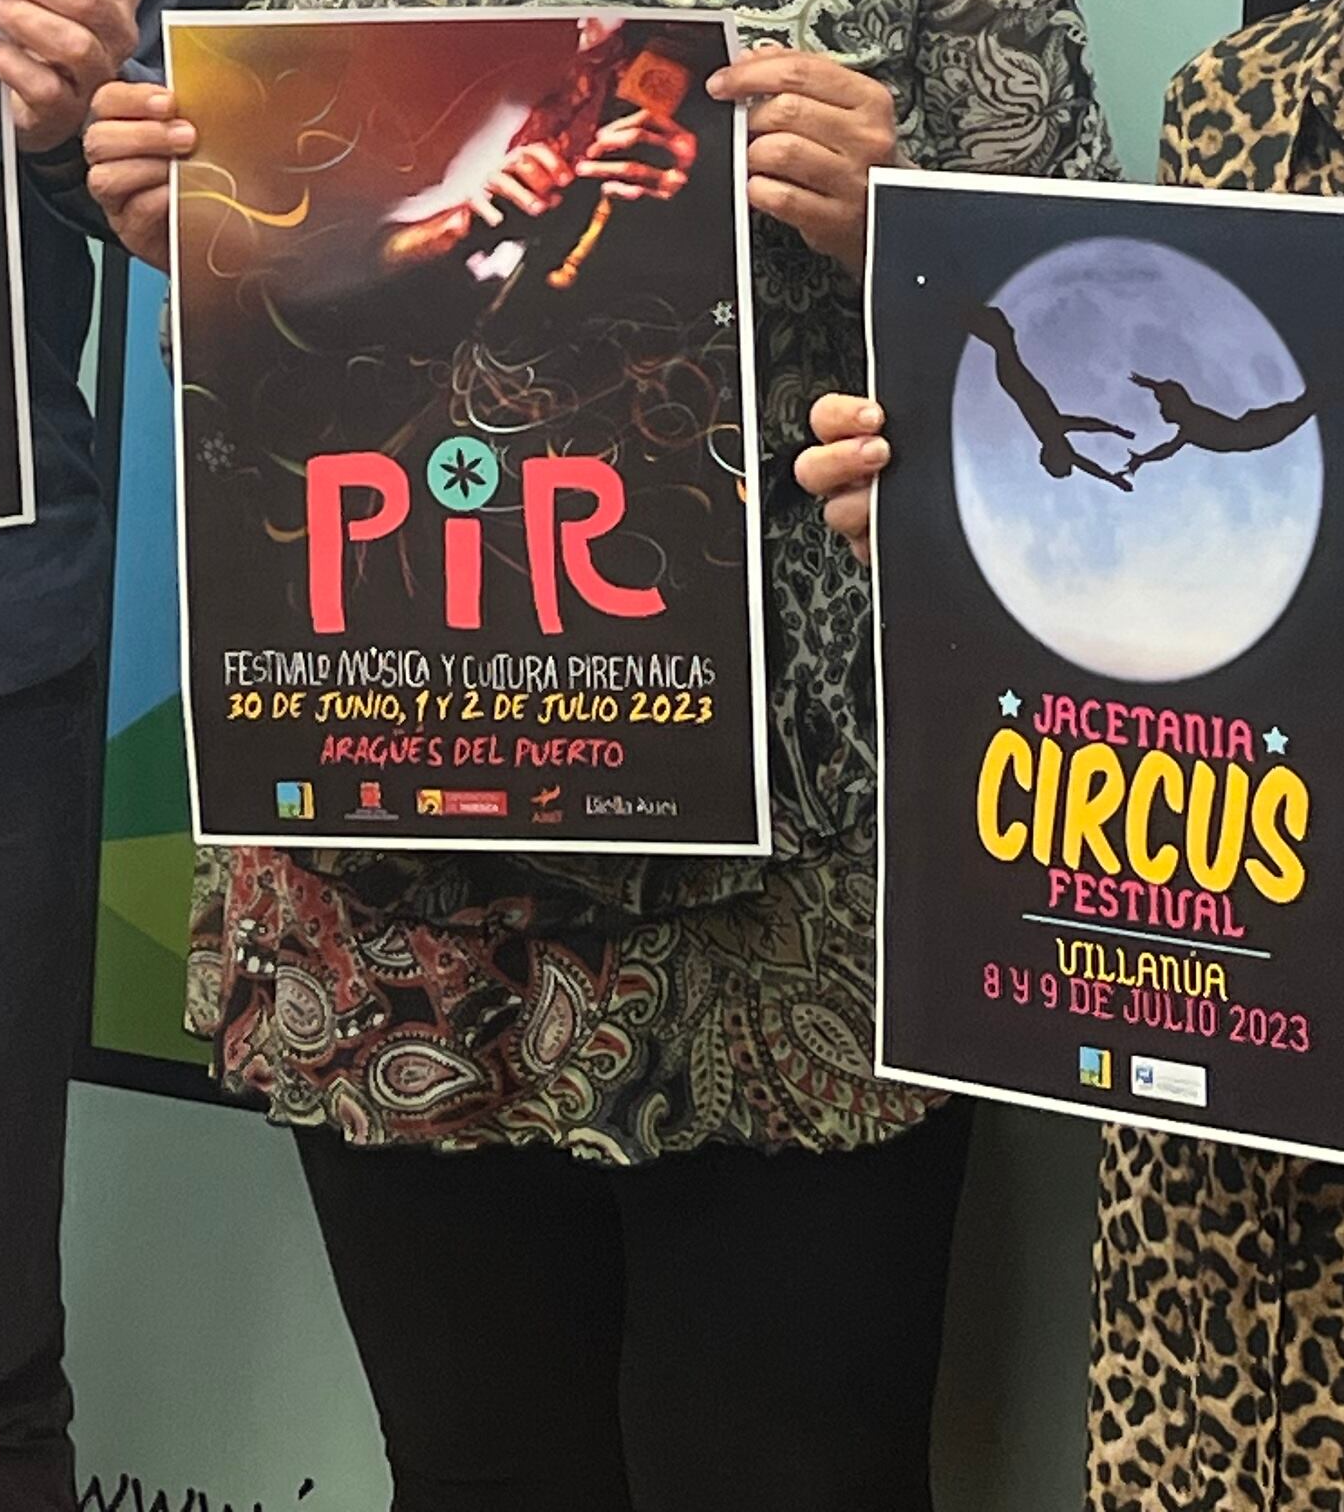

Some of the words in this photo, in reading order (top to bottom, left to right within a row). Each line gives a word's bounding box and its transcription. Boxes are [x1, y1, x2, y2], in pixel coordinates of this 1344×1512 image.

[337, 645, 431, 688] MÚSICA
[440, 654, 456, 686] Y
[462, 653, 559, 692] CULTURA
[225, 692, 264, 722] 30
[272, 692, 306, 719] DE
[314, 691, 407, 727] JUNIO,
[415, 689, 427, 724] 1
[434, 691, 455, 723] Y
[460, 692, 485, 722] 2
[493, 693, 531, 722] DE
[537, 691, 619, 724] JULIO
[628, 693, 714, 724] 2023
[1032, 691, 1255, 763] JACETANIA
[319, 724, 444, 770] ARAGÜÉS
[453, 736, 504, 766] DEL
[513, 738, 625, 768] PUERTO
[977, 727, 1310, 905] CIRCUS
[1048, 867, 1245, 938] FESTIVAL
[1055, 938, 1228, 1002] VILLANÚA
[983, 963, 1002, 1000] 8
[1039, 973, 1059, 1009] 9
[1068, 978, 1115, 1020] DE
[1122, 988, 1218, 1037] JULIO
[1228, 1003, 1311, 1054] 2023
